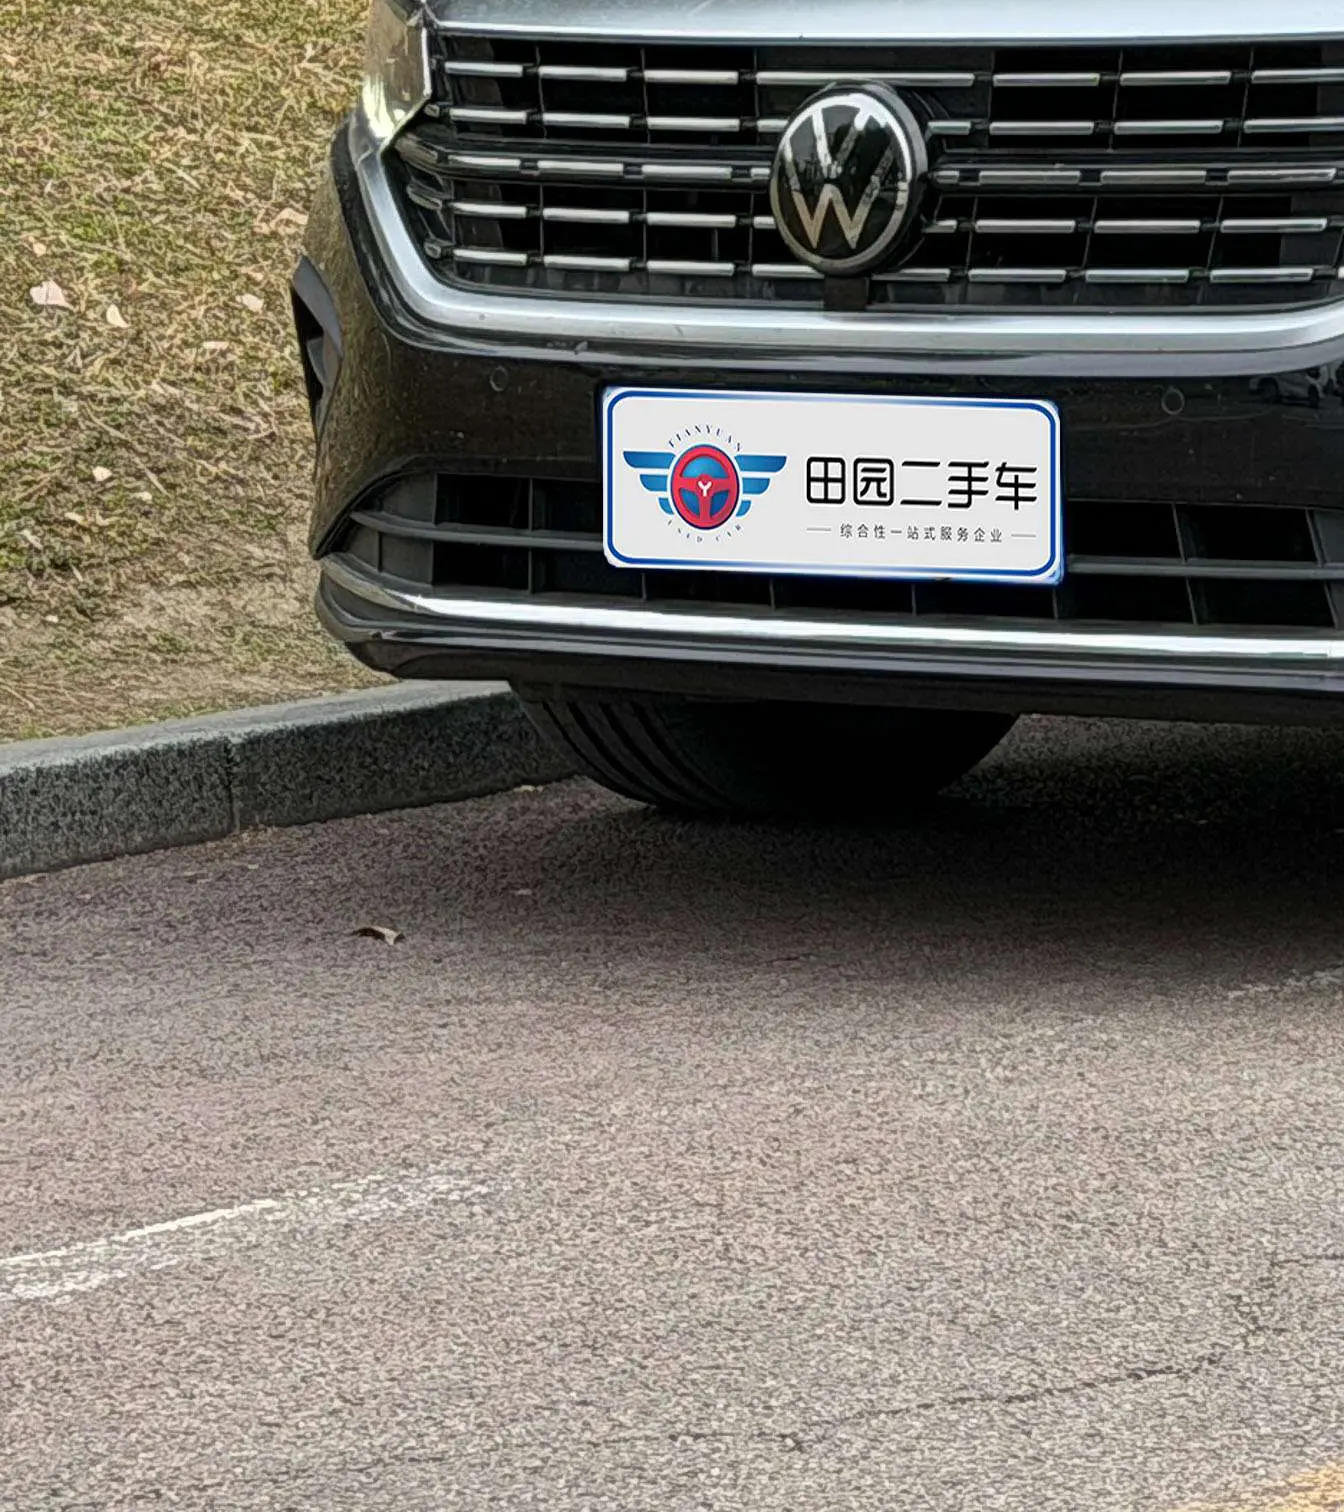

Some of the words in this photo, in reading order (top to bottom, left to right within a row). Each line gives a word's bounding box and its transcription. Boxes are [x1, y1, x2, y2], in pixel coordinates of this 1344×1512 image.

[806, 456, 1038, 511] 田园二手车
[839, 522, 1003, 544] 综合性一站式服务企业
